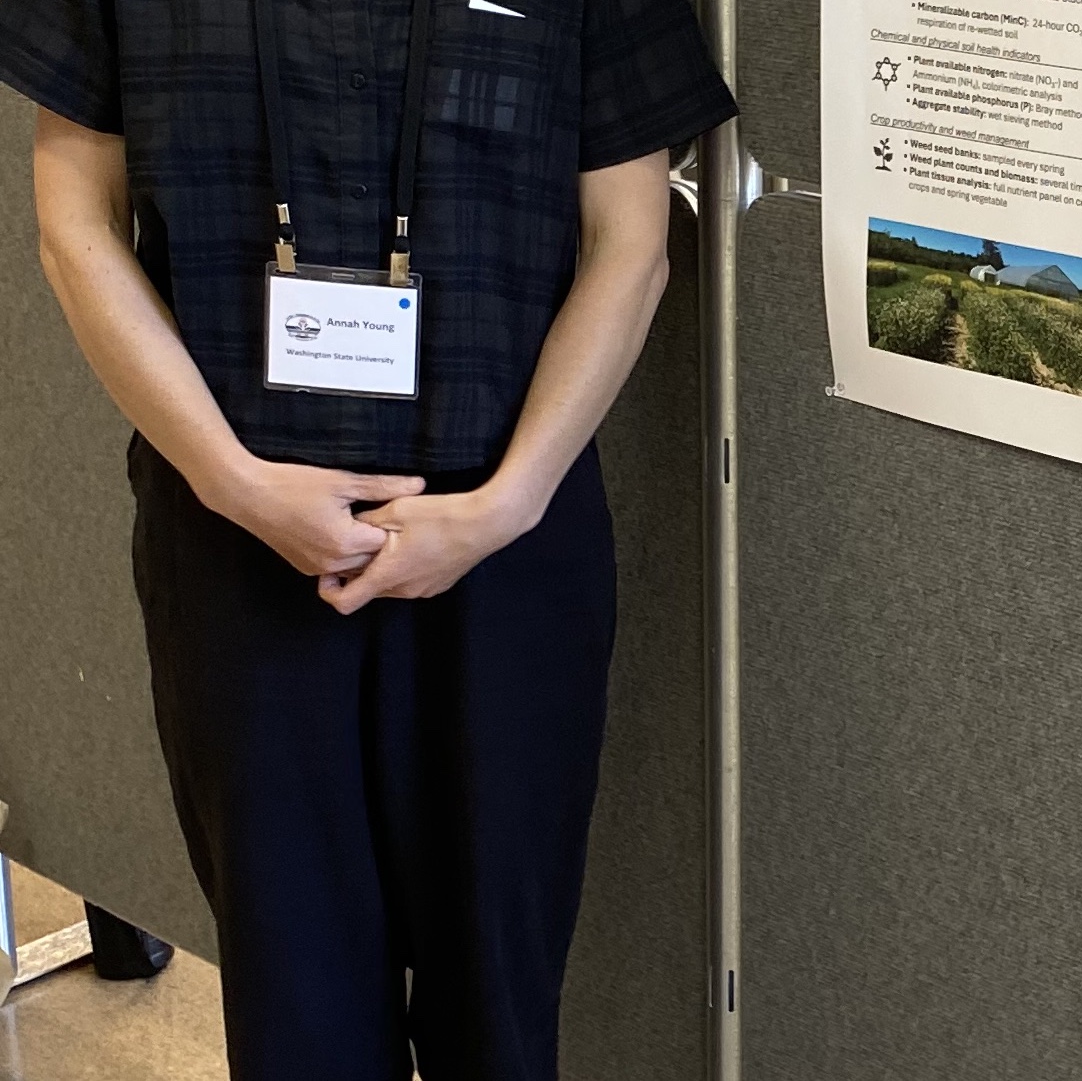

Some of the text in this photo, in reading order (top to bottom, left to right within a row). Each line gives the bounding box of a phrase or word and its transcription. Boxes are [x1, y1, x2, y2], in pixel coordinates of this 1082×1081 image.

[327, 318, 395, 333] Annah Young
[286, 348, 395, 365] Washington State University
